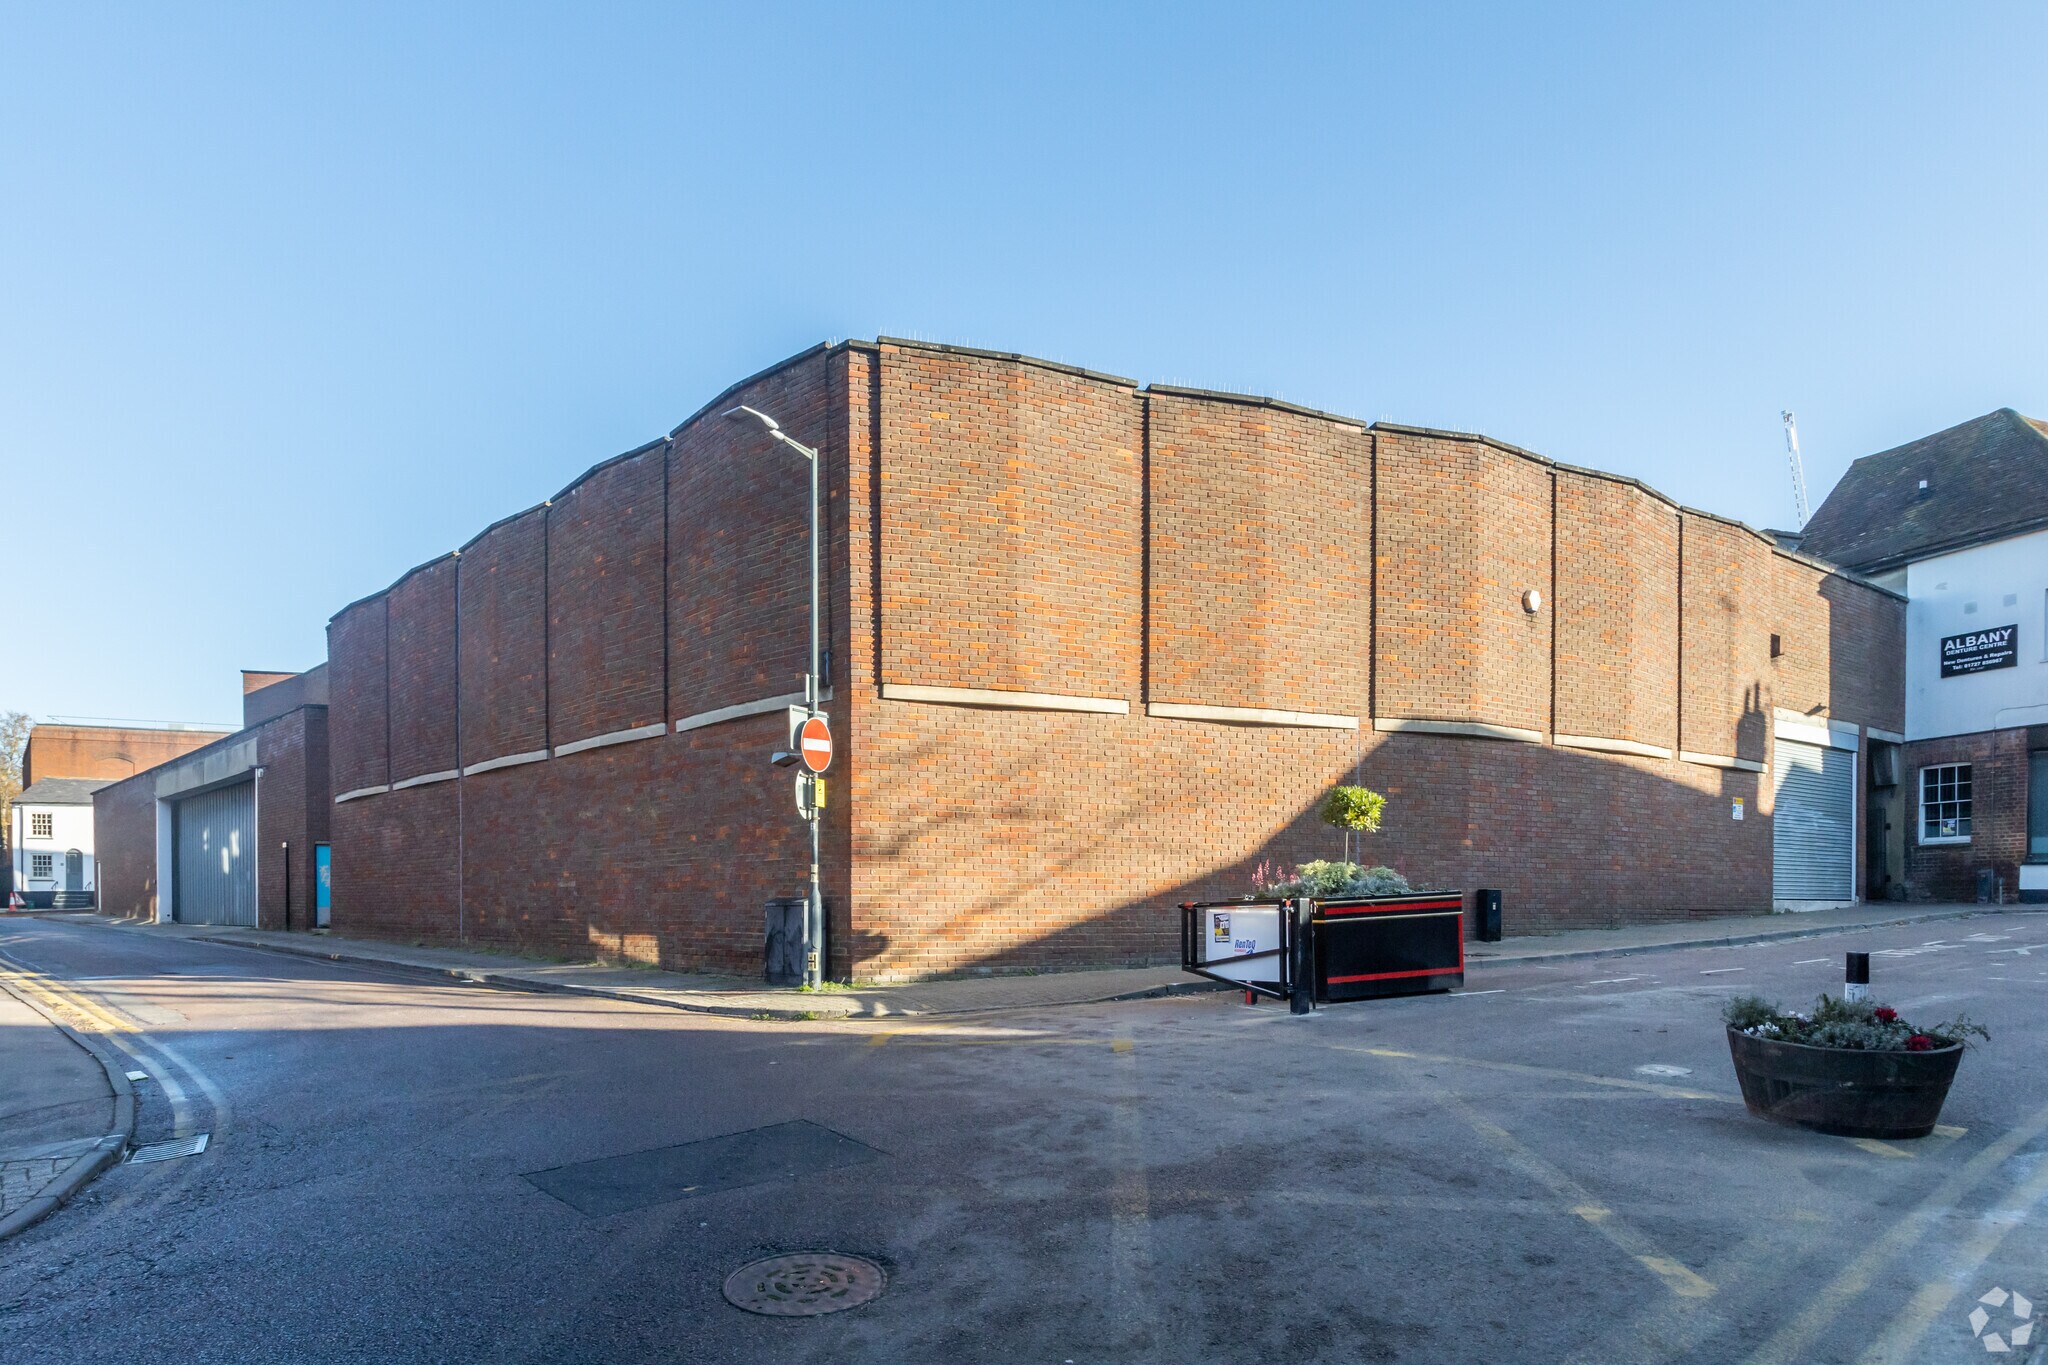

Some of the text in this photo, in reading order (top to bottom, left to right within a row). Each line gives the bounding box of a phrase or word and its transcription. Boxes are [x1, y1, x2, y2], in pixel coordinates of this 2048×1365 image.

[1944, 629, 2012, 651] ALBANY
[1946, 641, 2007, 656] DENTURE CENTRE
[1956, 655, 1982, 664] Dentures
[1989, 650, 2013, 658] Repairs
